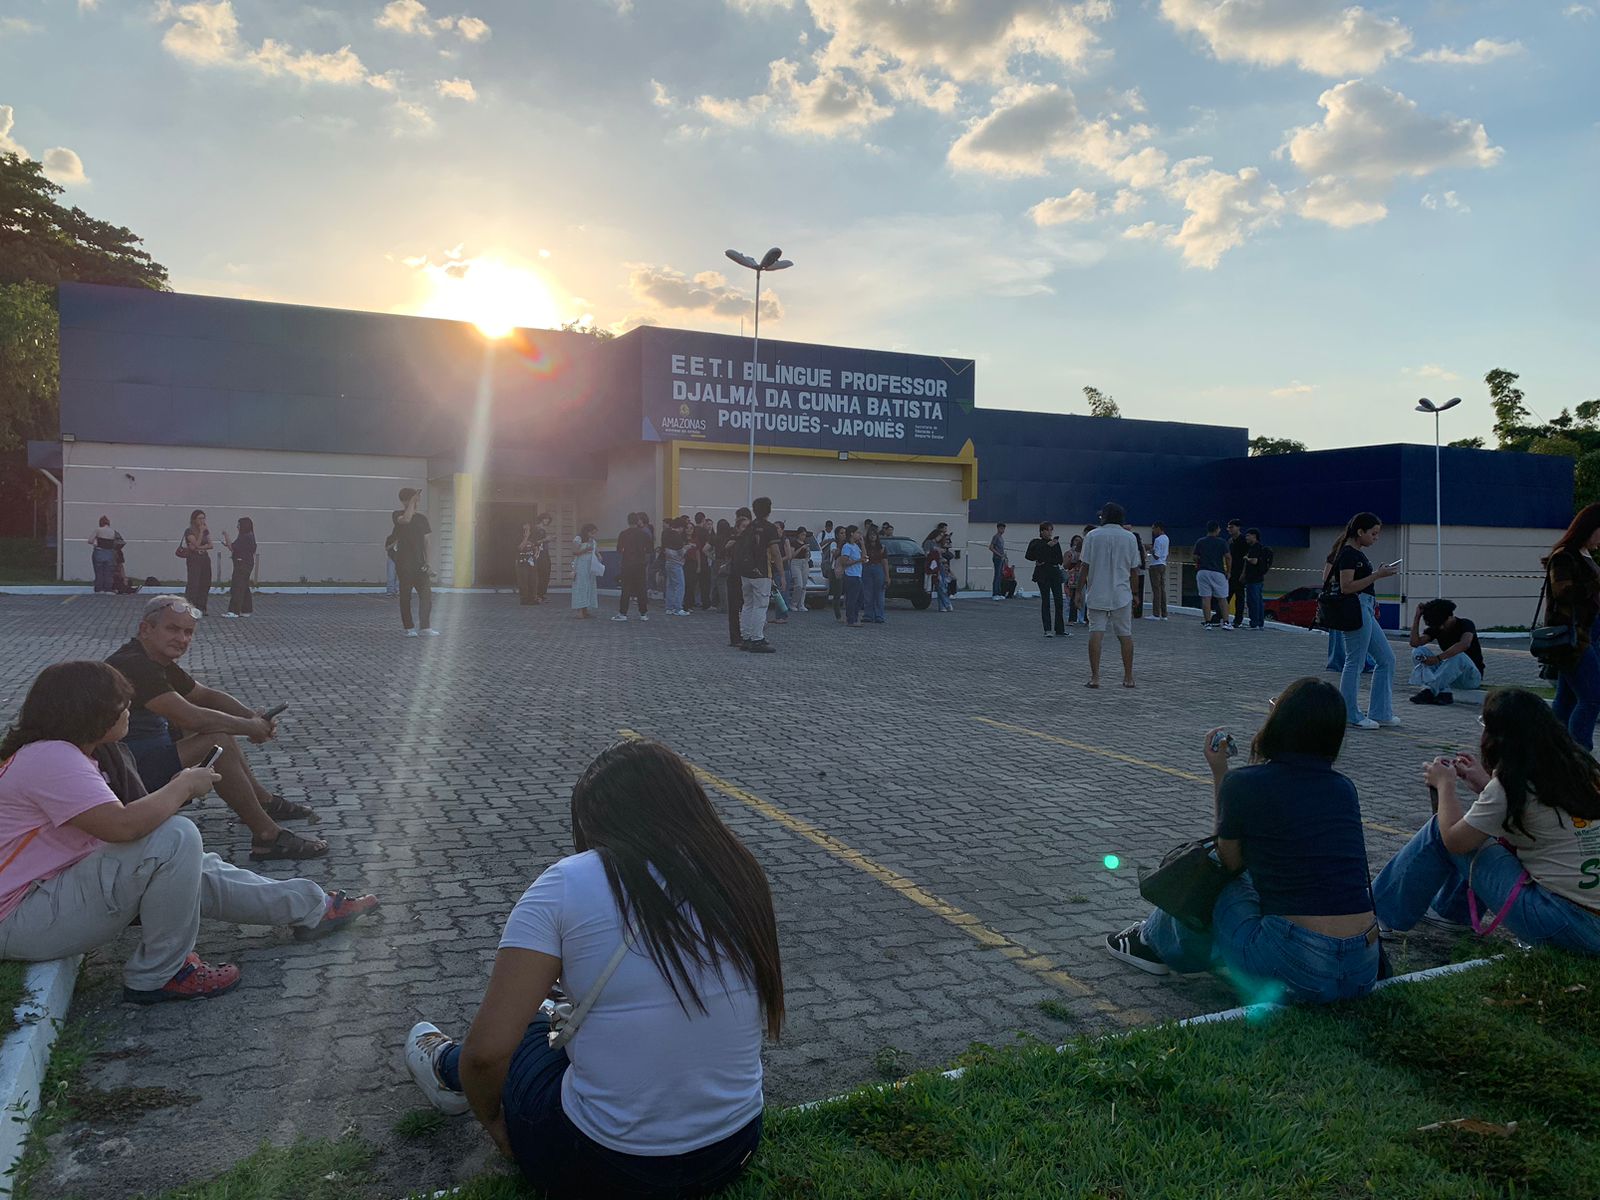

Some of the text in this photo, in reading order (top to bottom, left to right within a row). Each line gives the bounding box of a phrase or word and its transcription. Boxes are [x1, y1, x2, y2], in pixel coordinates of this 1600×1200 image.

[743, 360, 831, 388] BILÍNGUE
[841, 371, 948, 398] PROFESSOR
[673, 380, 943, 420] DJALMA DA CUNHA BATISTA
[661, 416, 706, 430] AMAZONAS
